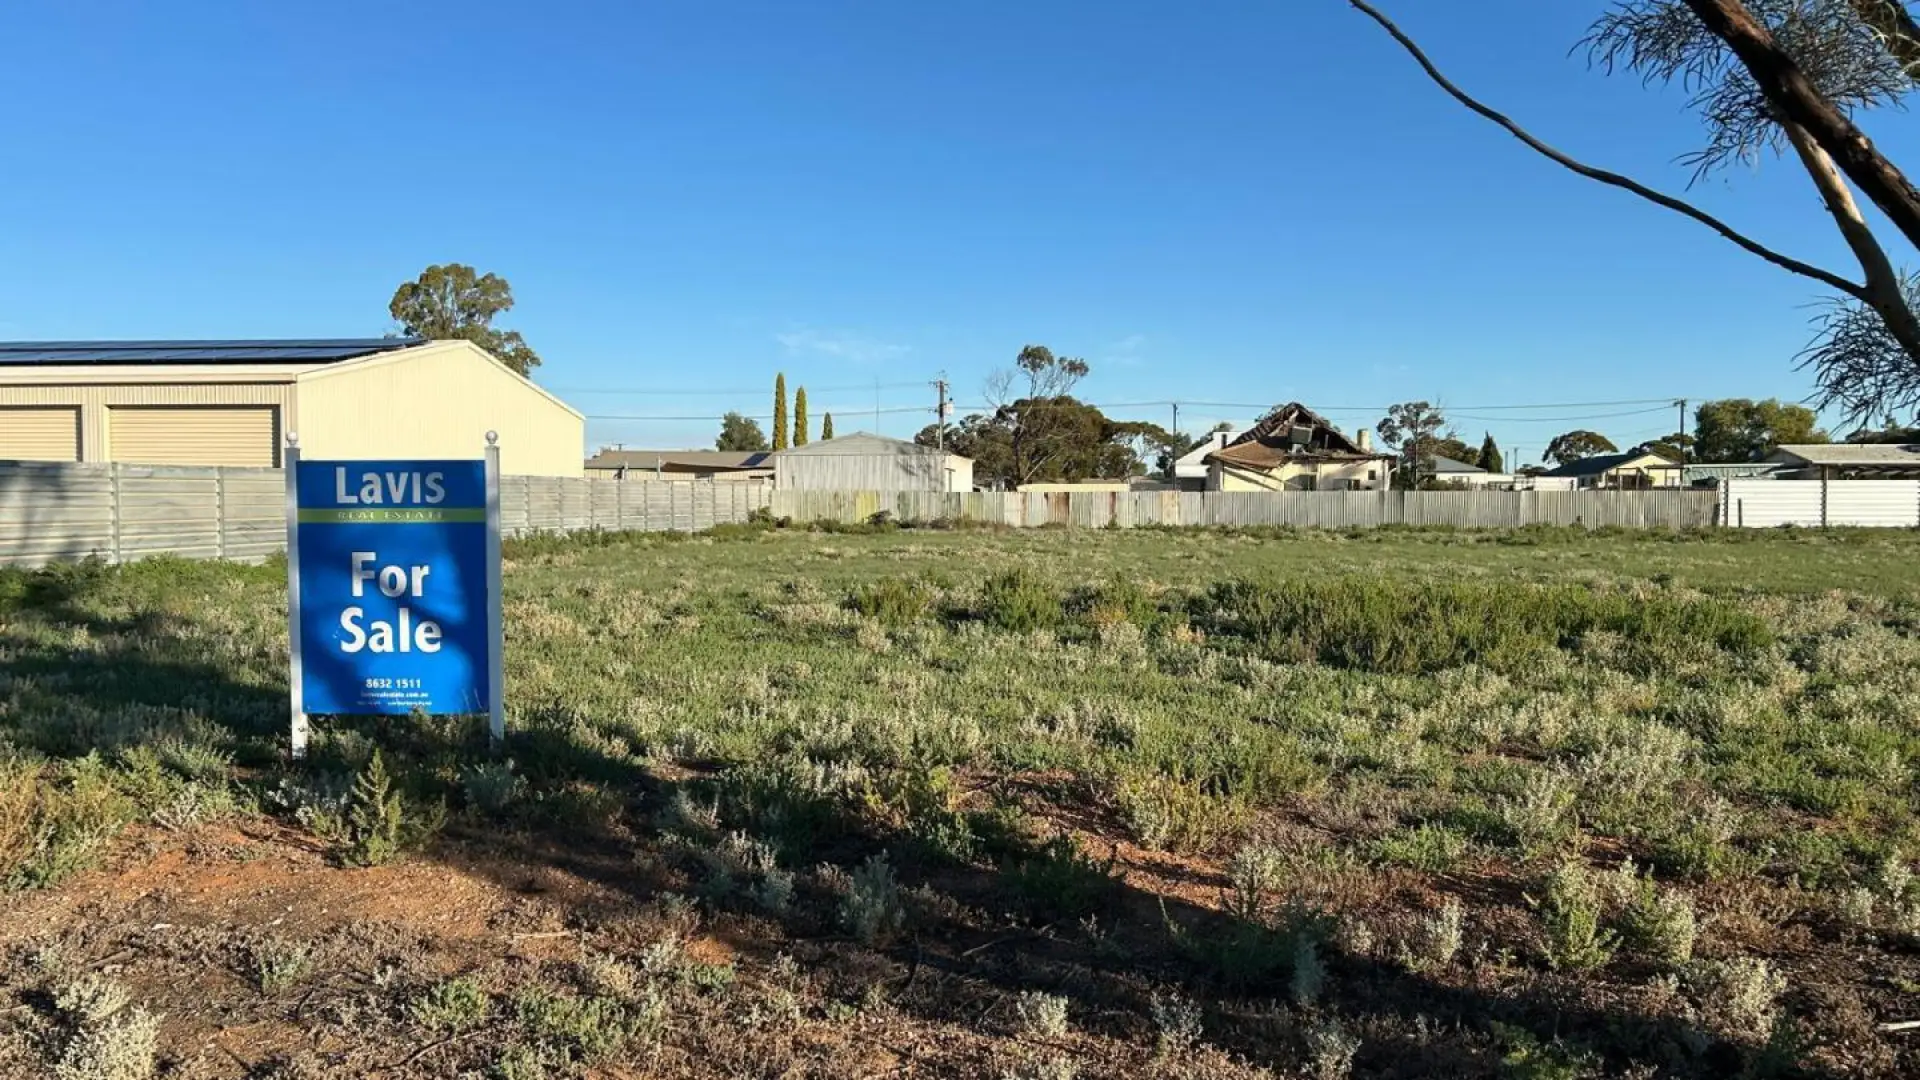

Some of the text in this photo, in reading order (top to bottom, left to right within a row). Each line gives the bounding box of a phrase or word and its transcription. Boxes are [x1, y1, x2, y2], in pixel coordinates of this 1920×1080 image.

[351, 551, 430, 597] For
[340, 606, 442, 653] Sale
[365, 678, 421, 689] 8632 1511
